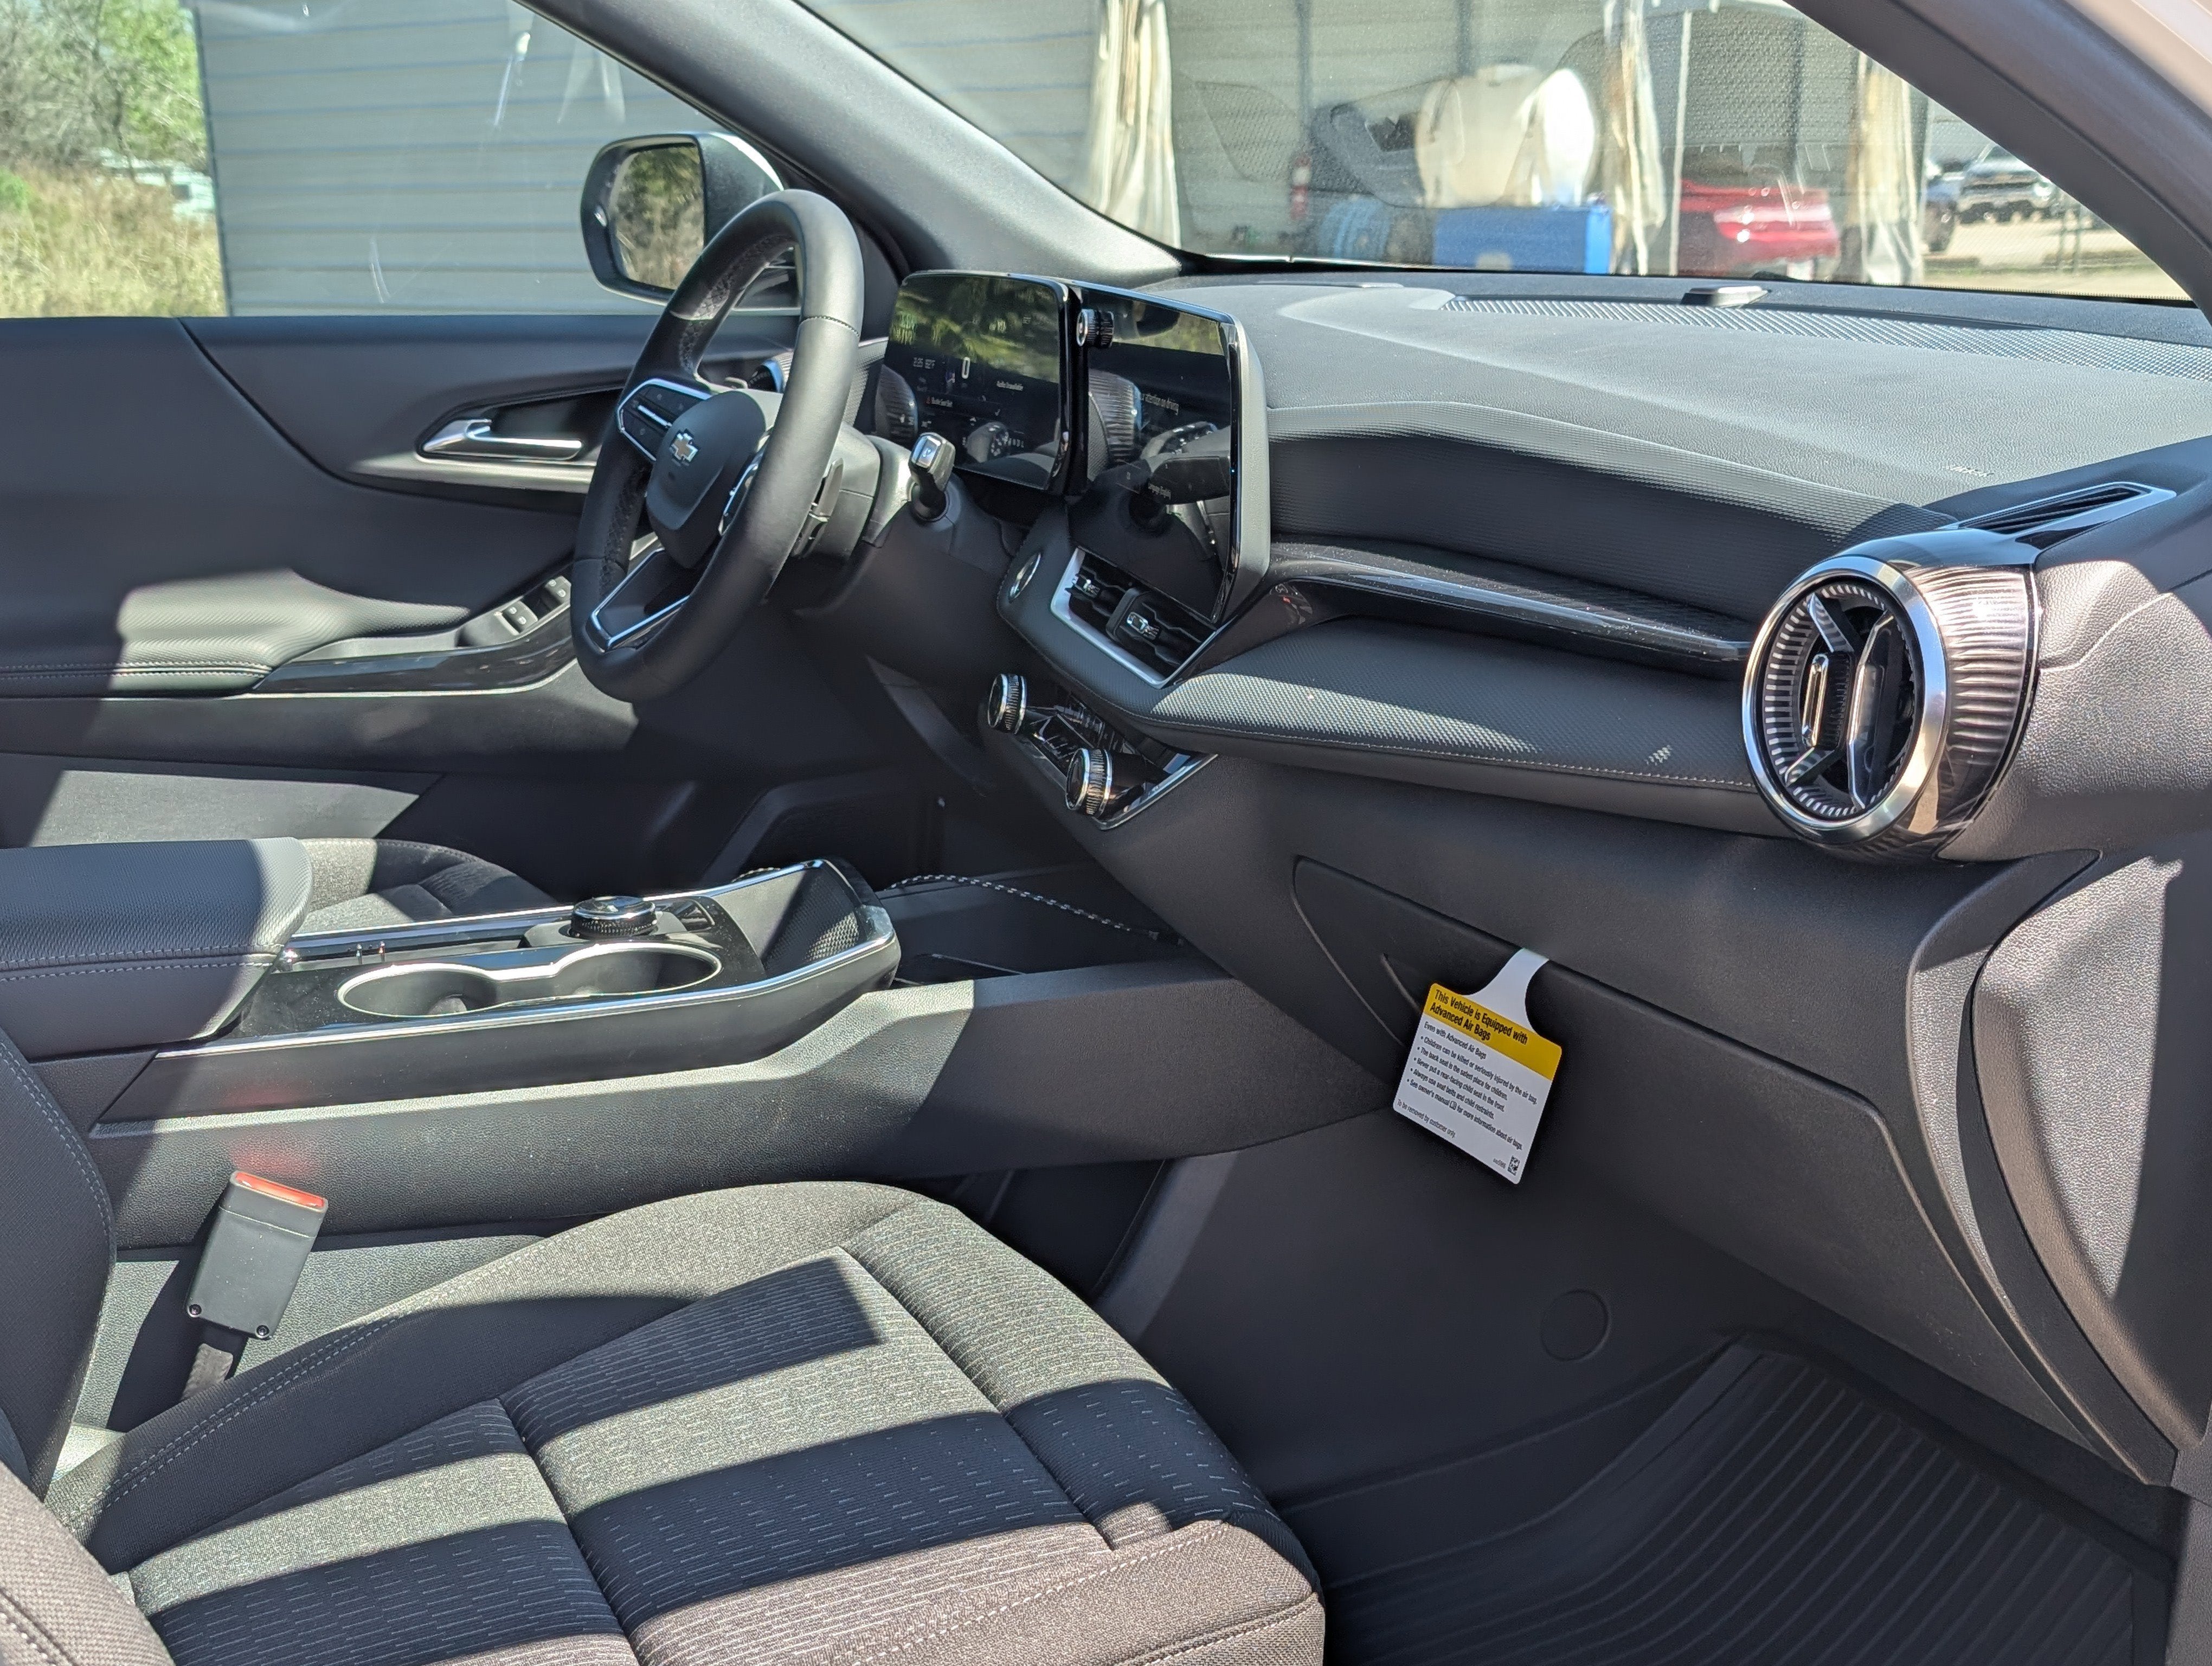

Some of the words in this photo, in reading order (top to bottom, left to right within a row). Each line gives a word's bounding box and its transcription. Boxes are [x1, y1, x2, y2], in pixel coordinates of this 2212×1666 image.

[962, 357, 970, 379] 0
[1430, 1002, 1464, 1026] Advanced
[1463, 1018, 1474, 1031] Air
[1474, 1023, 1490, 1041] Bags
[1435, 989, 1449, 1004] This
[1450, 997, 1474, 1016] Vehicle
[1474, 1009, 1481, 1020] is
[1481, 1013, 1513, 1036] Equipped
[1513, 1031, 1528, 1045] with
[1424, 1021, 1435, 1032] Even
[1436, 1029, 1446, 1038] with
[1446, 1033, 1468, 1049] Advanced
[1475, 1048, 1487, 1059] Bags
[1417, 1058, 1429, 1069] Never
[1463, 1084, 1474, 1093] child
[1473, 1090, 1482, 1099] seat
[1482, 1093, 1487, 1101] in
[1420, 1047, 1429, 1056] The
[1429, 1051, 1439, 1061] back
[1439, 1059, 1449, 1067] seat
[1460, 1069, 1473, 1080] safest
[1472, 1077, 1484, 1087] place
[1424, 1036, 1442, 1050] Children
[1442, 1047, 1450, 1055] can
[1451, 1050, 1456, 1059] be
[1457, 1054, 1469, 1065] killed
[1474, 1065, 1494, 1080] seriously
[1494, 1074, 1509, 1087] injured
[1509, 1082, 1515, 1092] by
[1413, 1069, 1428, 1081] Always
[1436, 1082, 1446, 1091] seat
[1446, 1086, 1456, 1097] belts
[1456, 1093, 1465, 1101] and
[1464, 1098, 1475, 1107] child
[1410, 1079, 1418, 1088] See
[1435, 1094, 1450, 1105] manual
[1463, 1110, 1474, 1120] more
[1474, 1115, 1496, 1133] information
[1495, 1130, 1507, 1140] about
